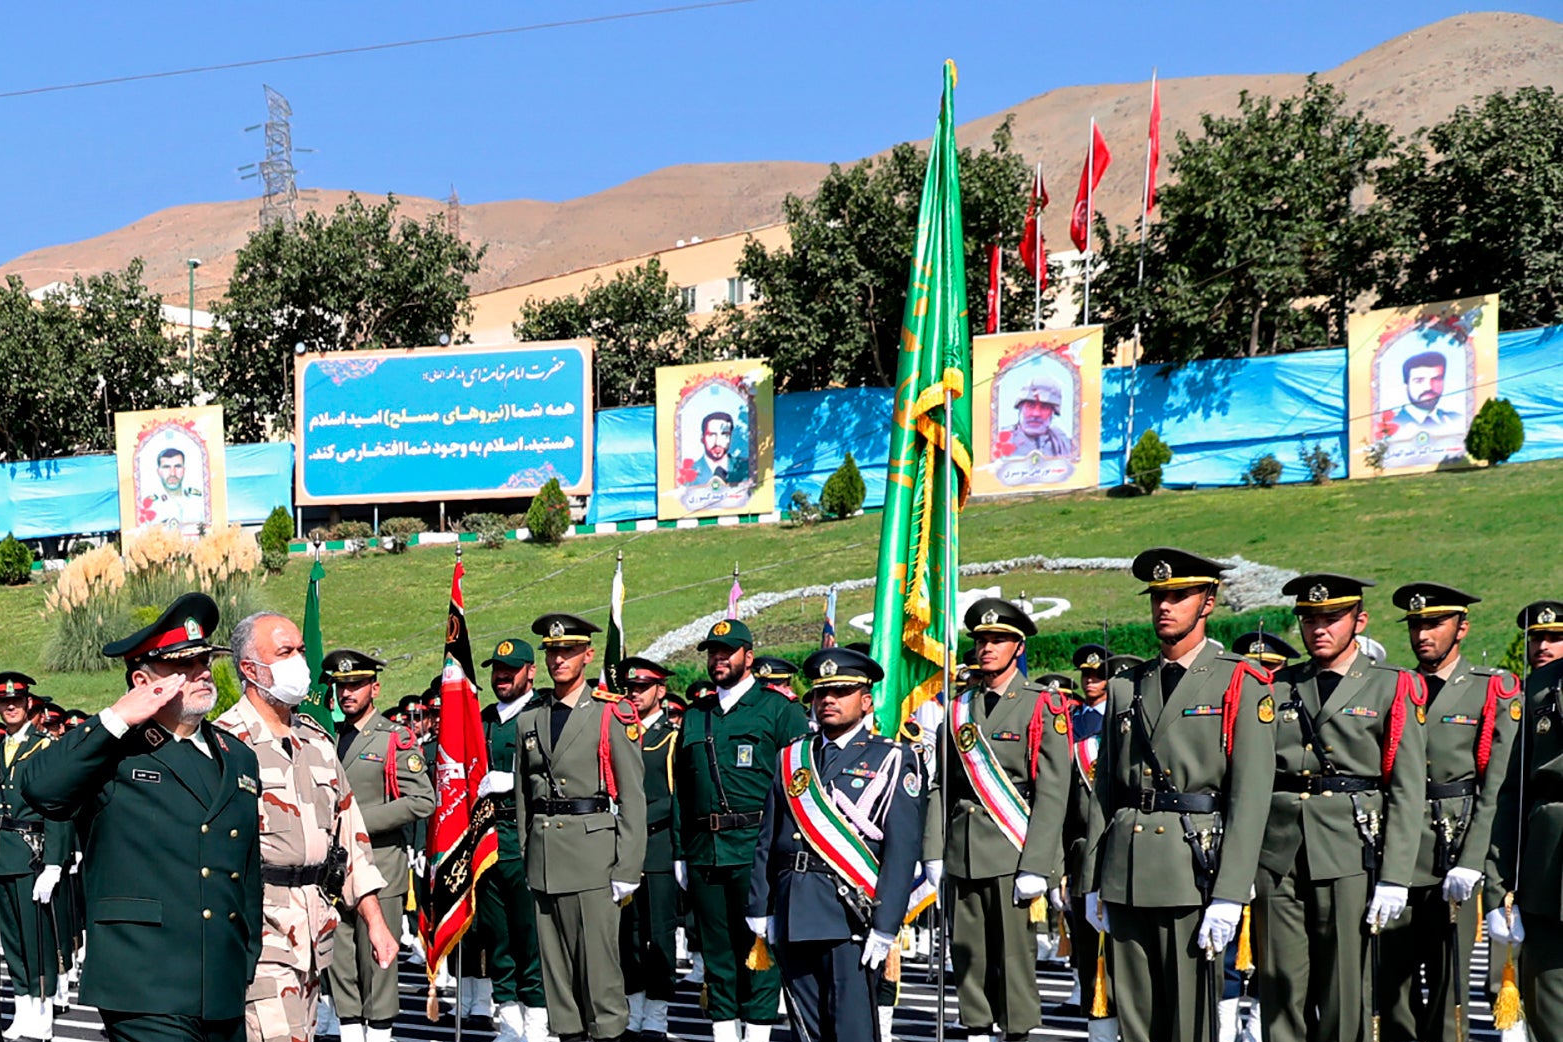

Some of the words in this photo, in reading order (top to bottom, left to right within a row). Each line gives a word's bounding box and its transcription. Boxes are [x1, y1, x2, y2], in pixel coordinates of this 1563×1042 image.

[525, 355, 566, 381] حضرت
[384, 407, 439, 429] مسلح)
[511, 402, 543, 418] شما
[545, 401, 575, 416] همه
[308, 410, 346, 433] اسلام
[346, 409, 383, 428] امید
[355, 440, 403, 462] افتخار
[404, 440, 432, 455] شما
[432, 440, 468, 459] وجود
[469, 440, 483, 456] به
[483, 436, 524, 458] اسلام
